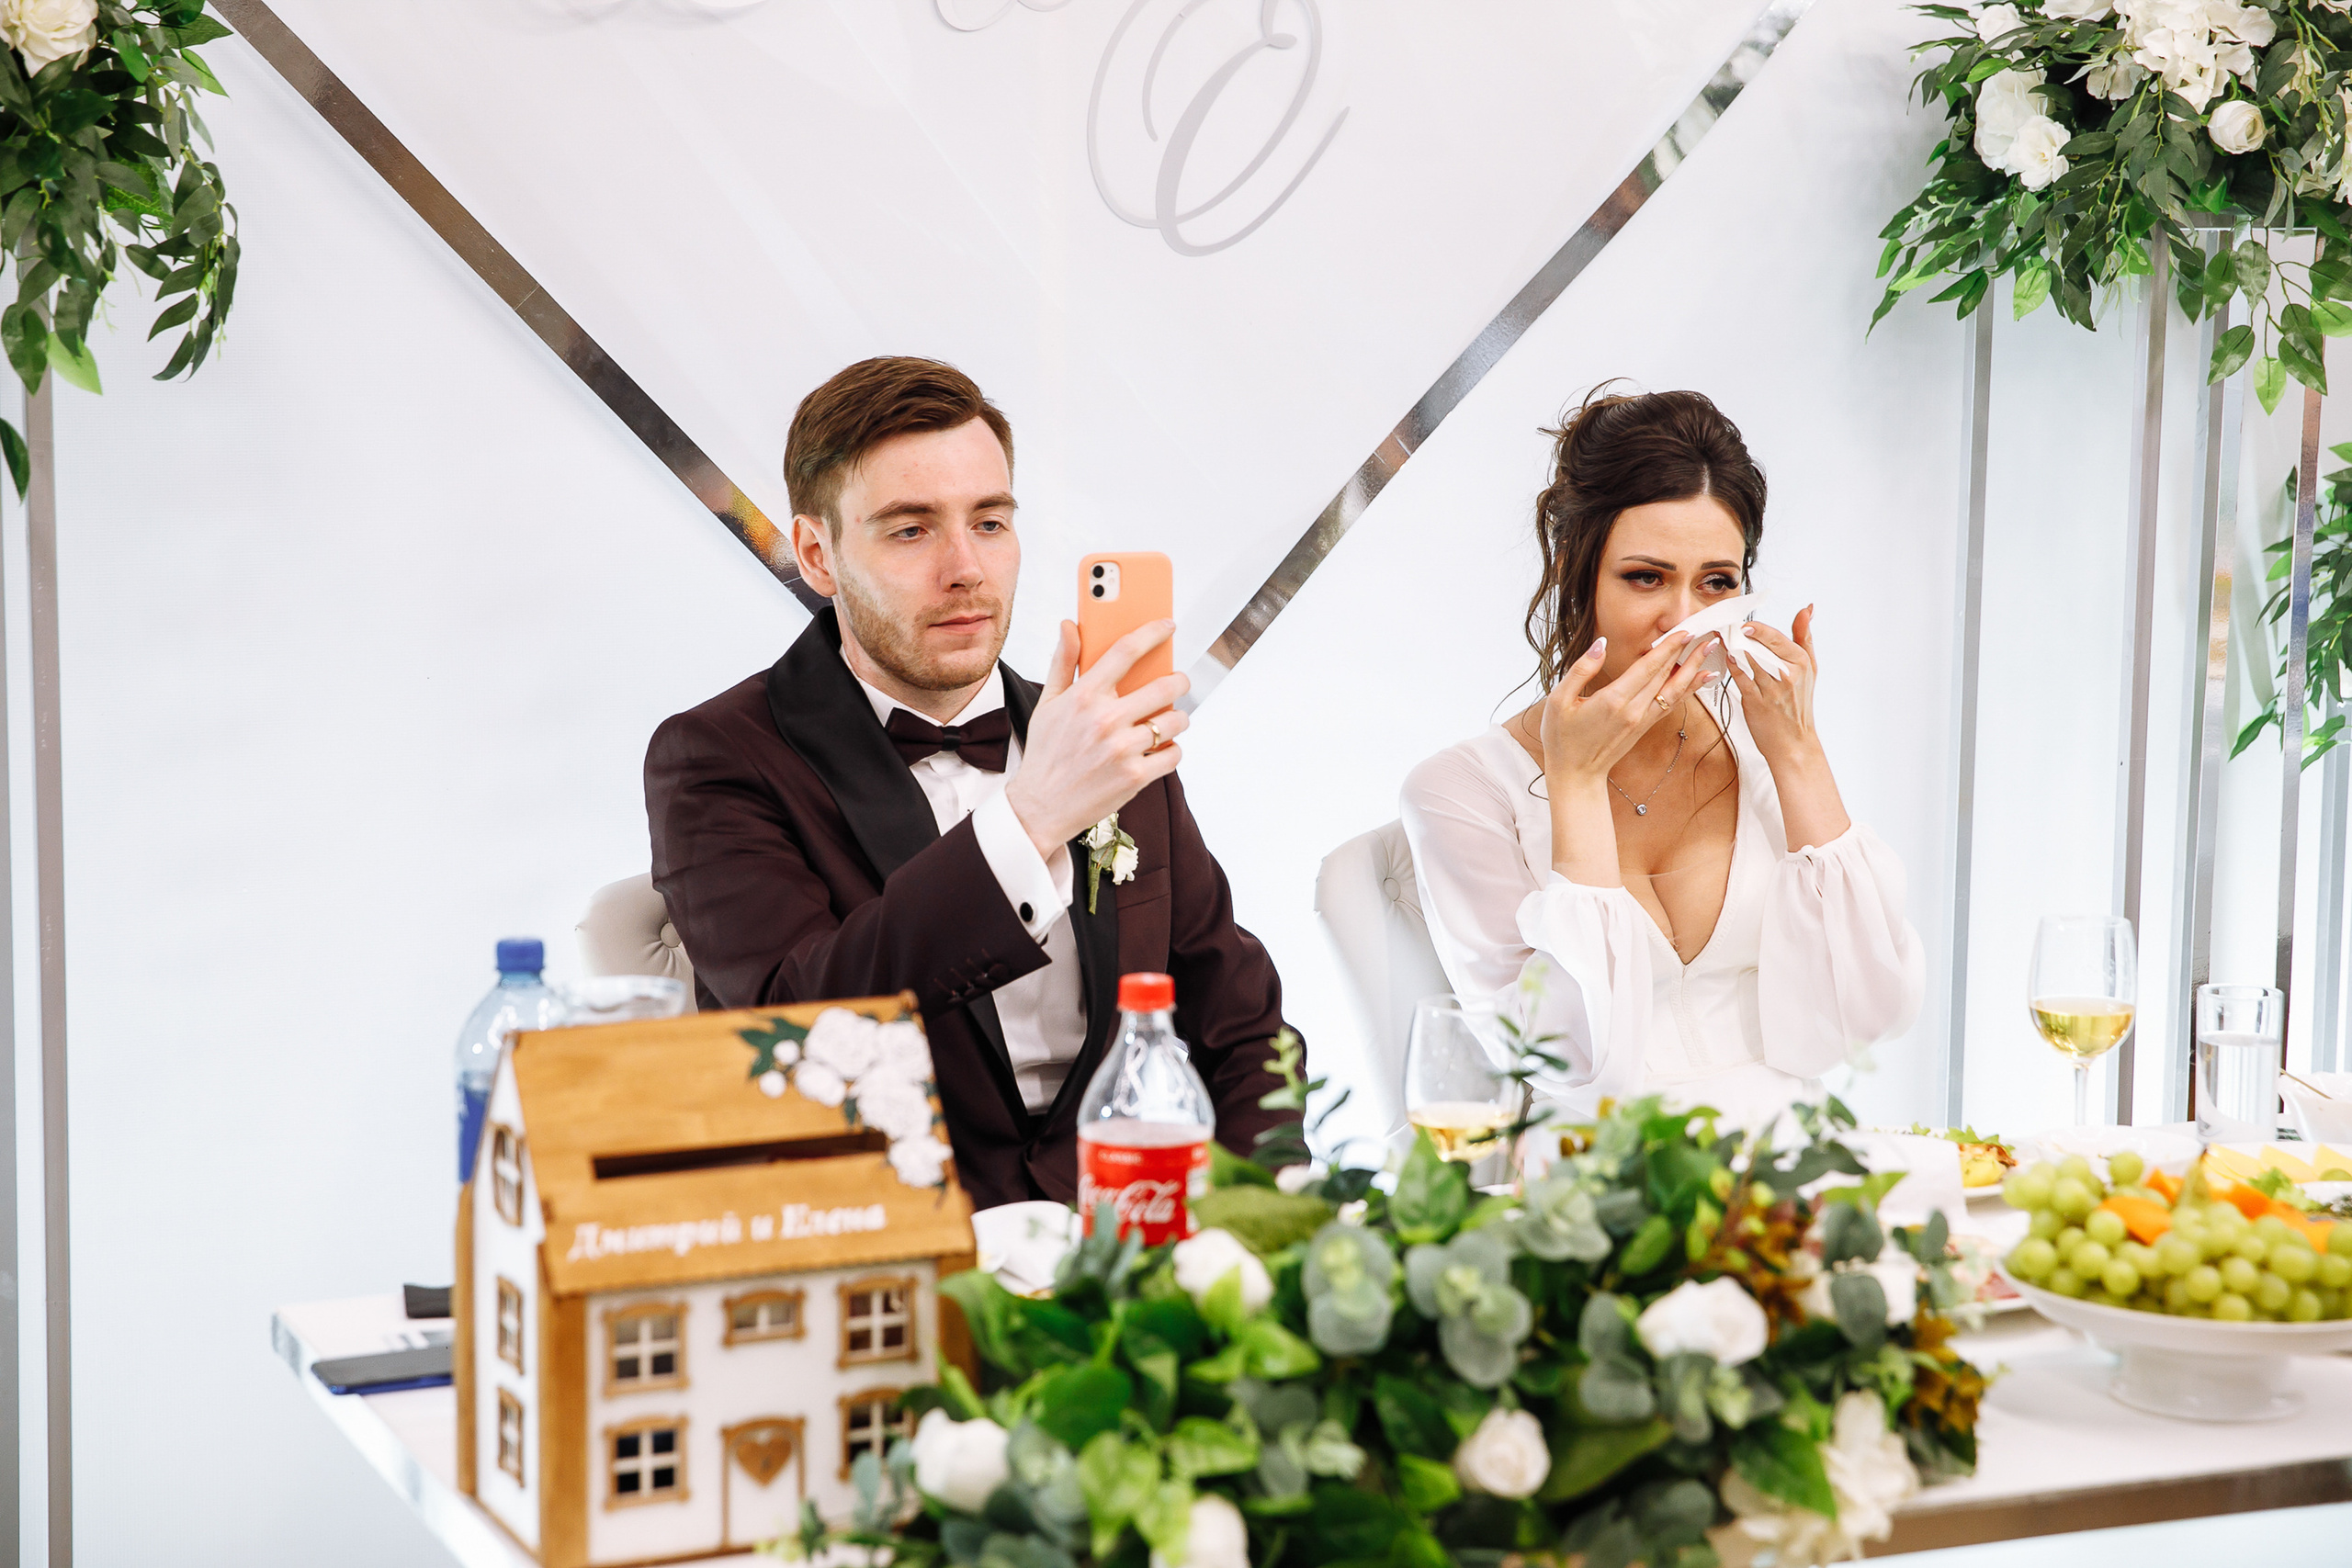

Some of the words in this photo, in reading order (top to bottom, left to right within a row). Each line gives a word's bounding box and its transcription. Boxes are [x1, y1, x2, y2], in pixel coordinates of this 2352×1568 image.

[566, 1211, 741, 1263] Дмитрий
[751, 1214, 774, 1241] и
[781, 1203, 887, 1239] Елена
